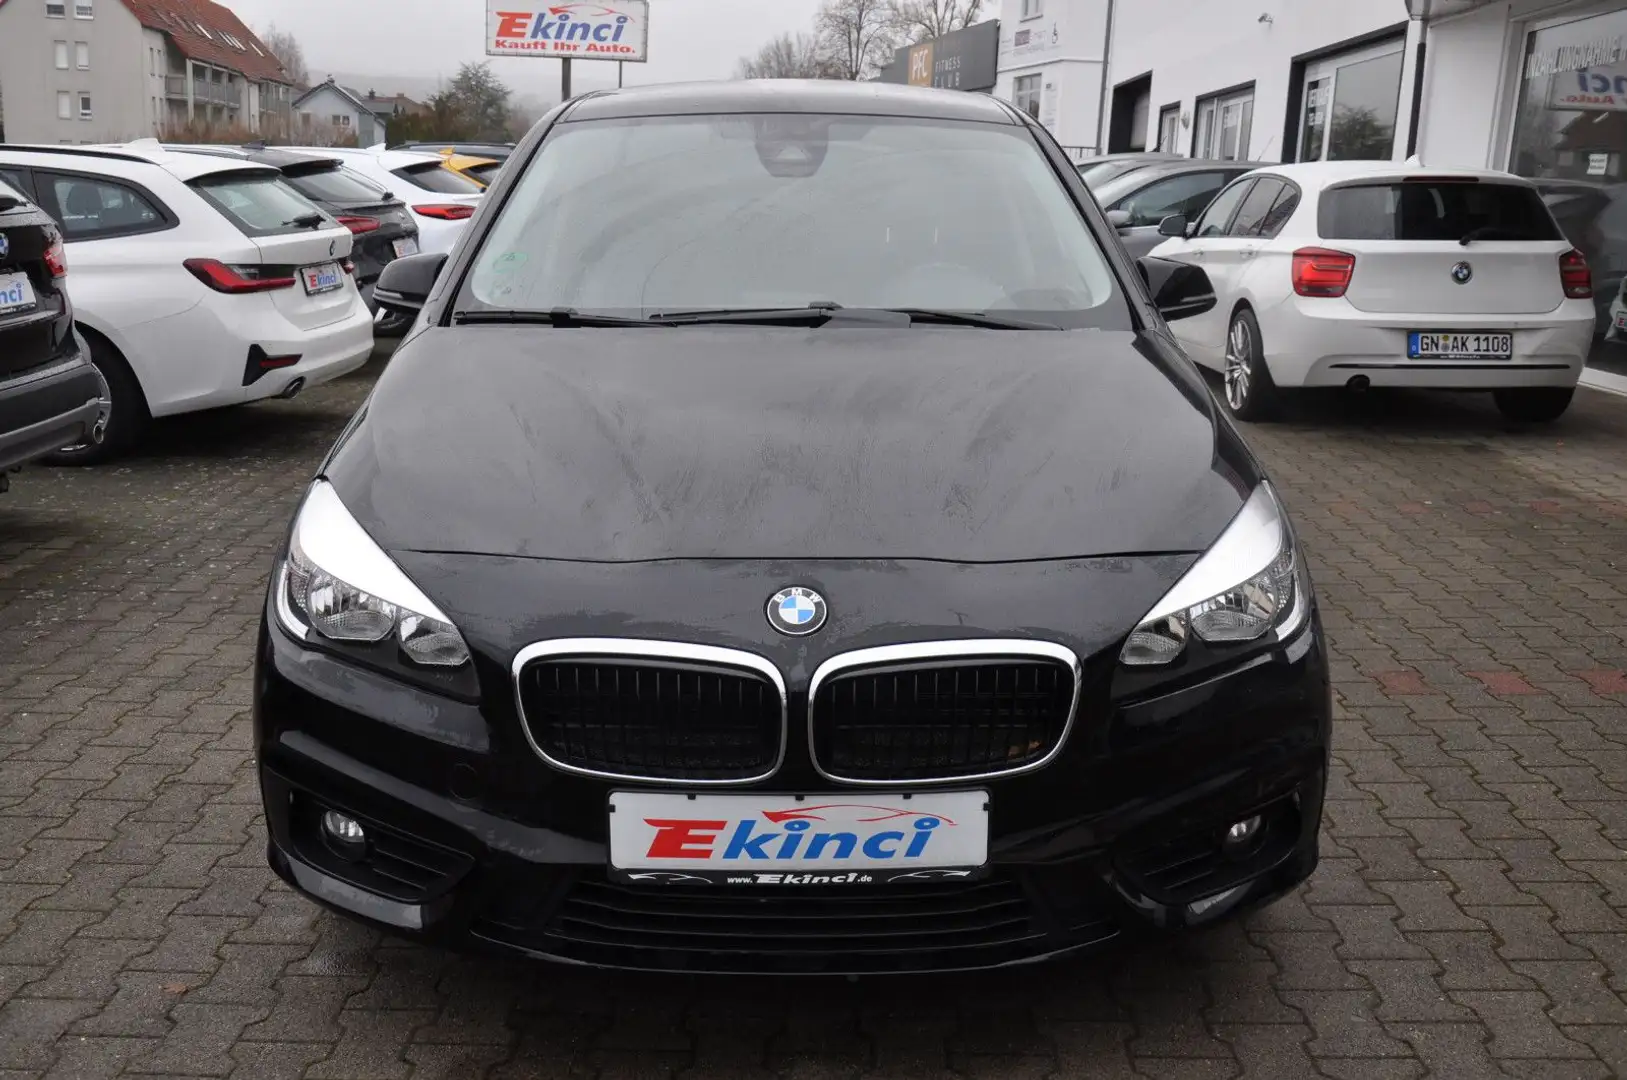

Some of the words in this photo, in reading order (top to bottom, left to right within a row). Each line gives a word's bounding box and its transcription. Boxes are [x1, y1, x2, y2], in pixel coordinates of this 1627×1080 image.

[495, 11, 628, 42] Ekinci
[495, 39, 547, 50] Kauft
[553, 41, 581, 52] Ihr
[586, 43, 636, 54] Auto.
[935, 55, 961, 73] FITNESS
[1420, 335, 1440, 352] GN
[1450, 335, 1470, 352] AK
[1473, 335, 1509, 352] 1108
[643, 816, 940, 861] Ekinci
[727, 872, 873, 885] www.Ekinci.de
